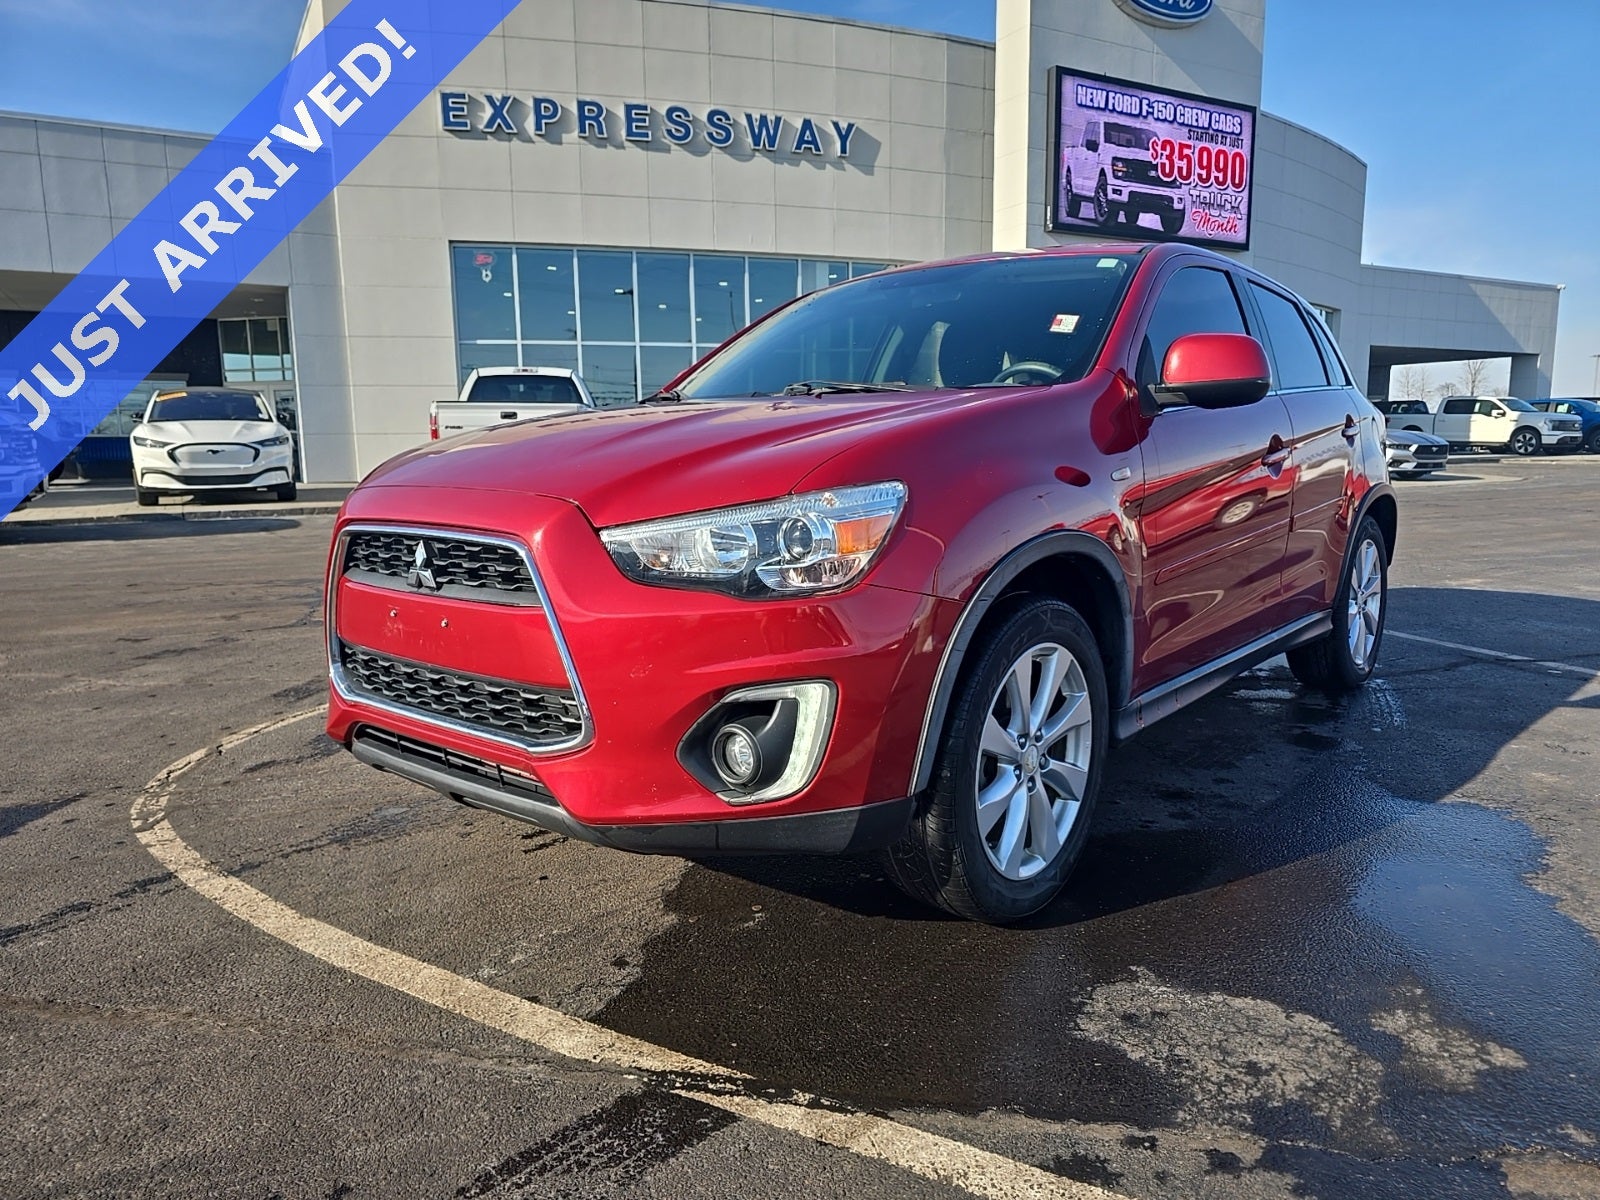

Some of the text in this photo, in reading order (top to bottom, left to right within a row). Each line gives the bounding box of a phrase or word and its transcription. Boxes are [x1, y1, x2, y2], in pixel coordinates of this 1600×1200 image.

[439, 92, 857, 156] EXPRESSWAY
[1076, 86, 1241, 134] NEW FORD F-150 CREW CABS
[1187, 130, 1244, 149] STARTING AT JUST
[1189, 189, 1243, 220] TRUCK
[1192, 210, 1239, 237] Month
